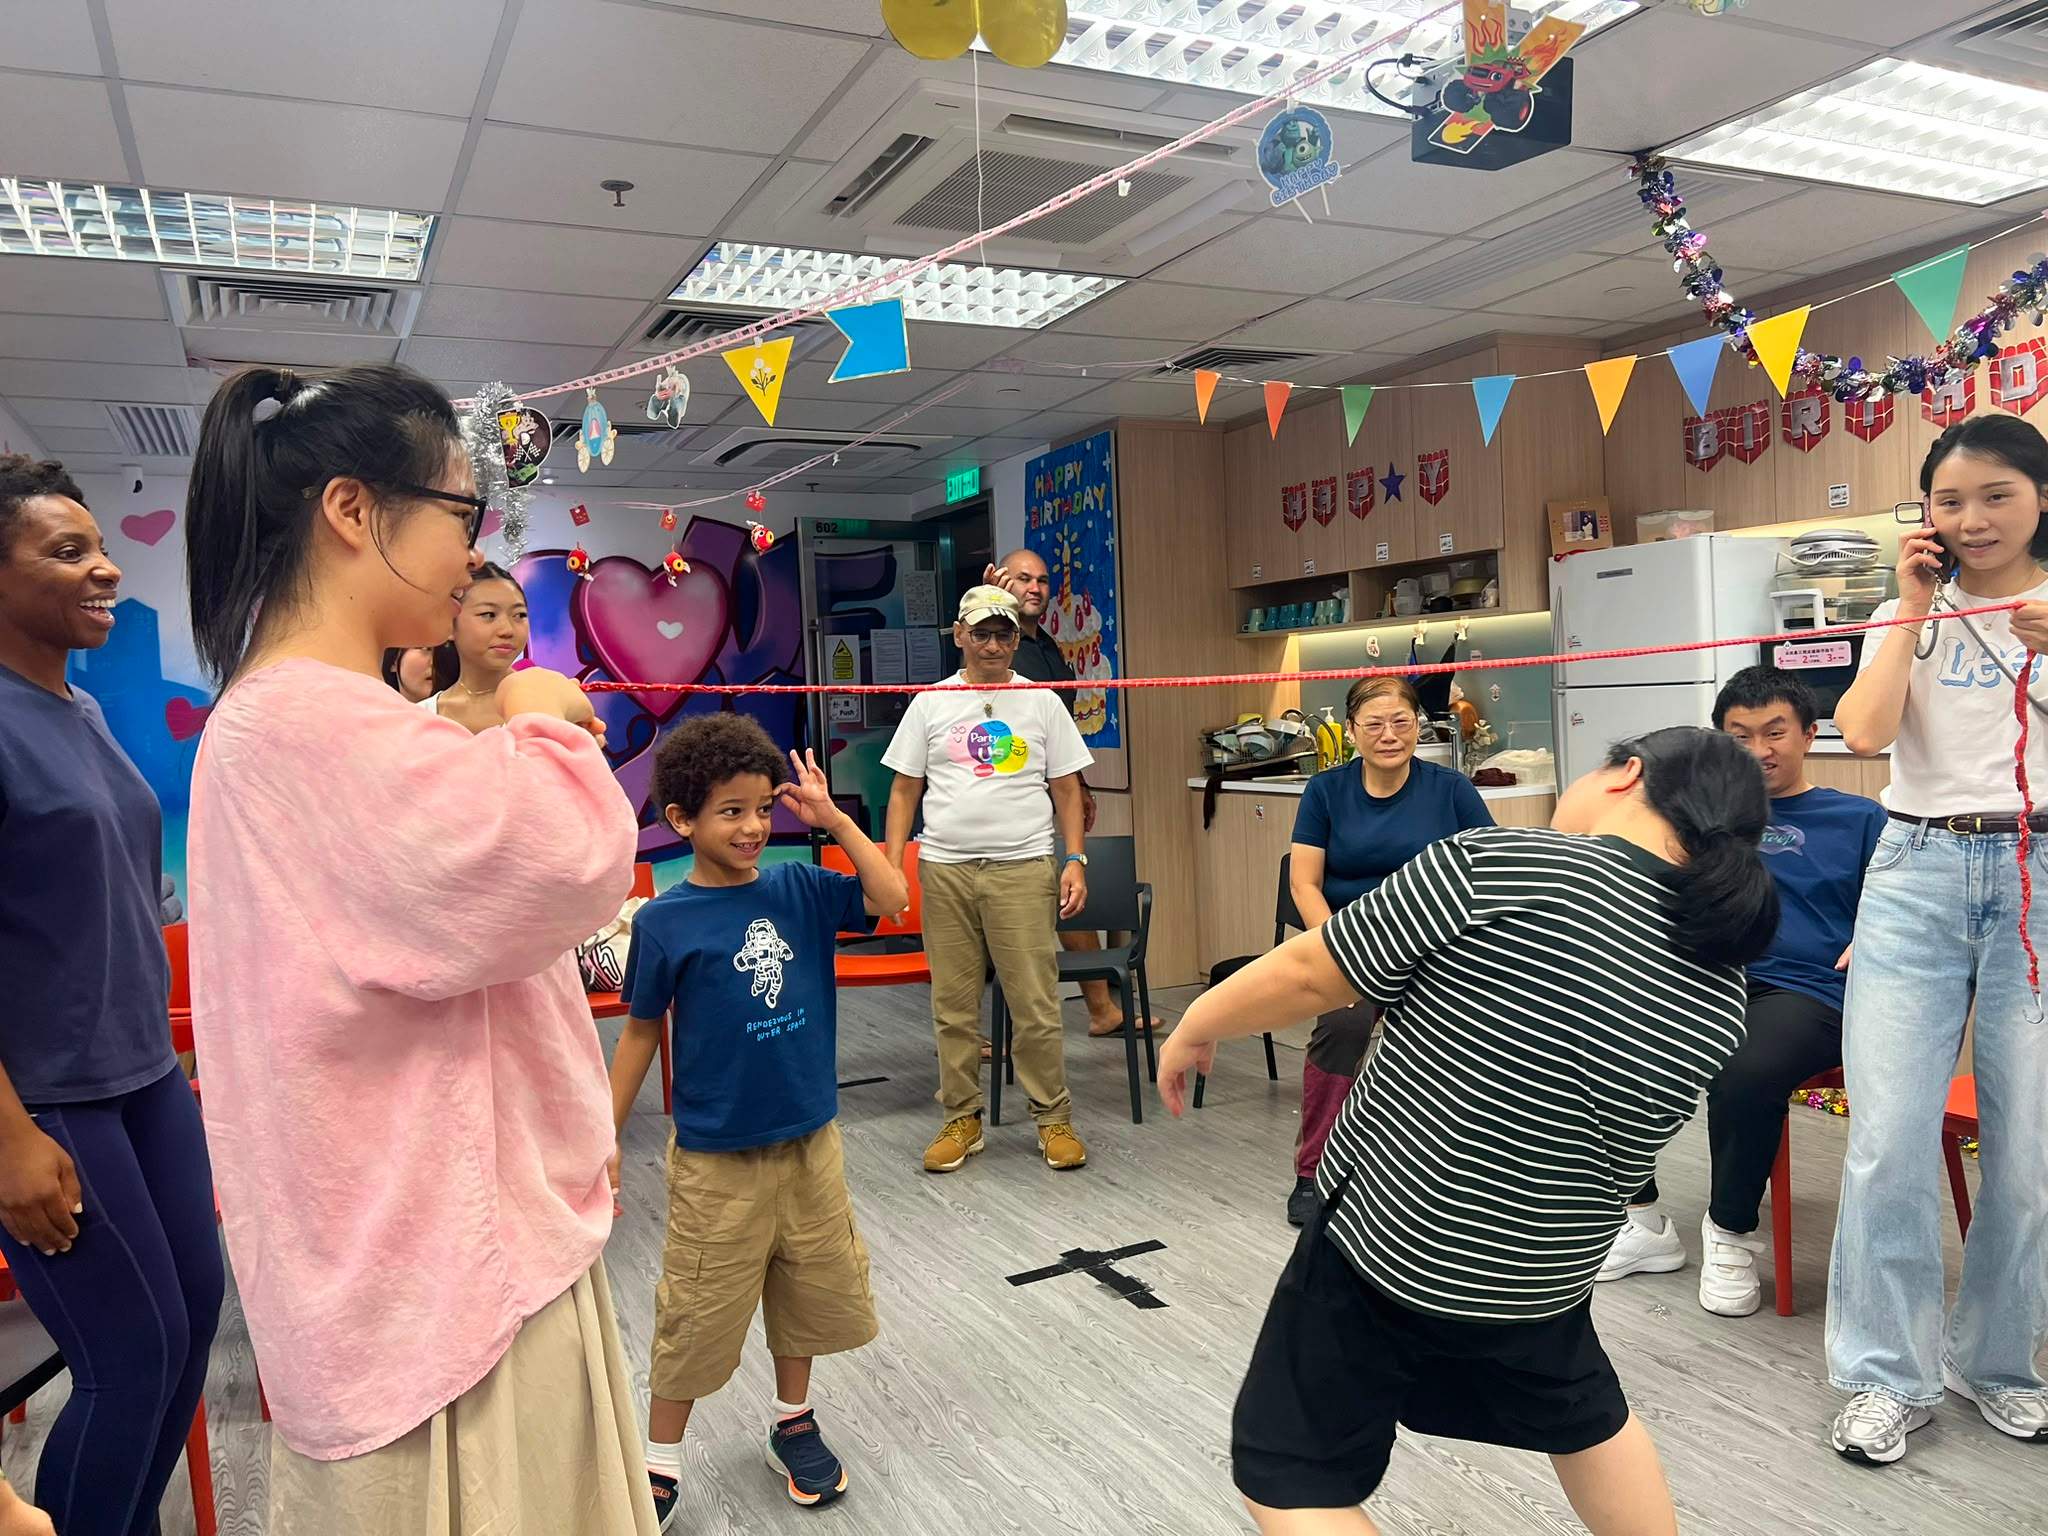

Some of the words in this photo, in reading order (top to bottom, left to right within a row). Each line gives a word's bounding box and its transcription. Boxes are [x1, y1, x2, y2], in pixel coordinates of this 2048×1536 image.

[1280, 159, 1323, 188] HAPPY
[1035, 461, 1082, 499] HAPPY
[1031, 483, 1105, 529] BIRTHDAY
[815, 522, 838, 533] 602
[970, 732, 1000, 745] Party
[746, 1011, 792, 1033] RENDEZVOUS
[756, 1026, 781, 1042] OUTER
